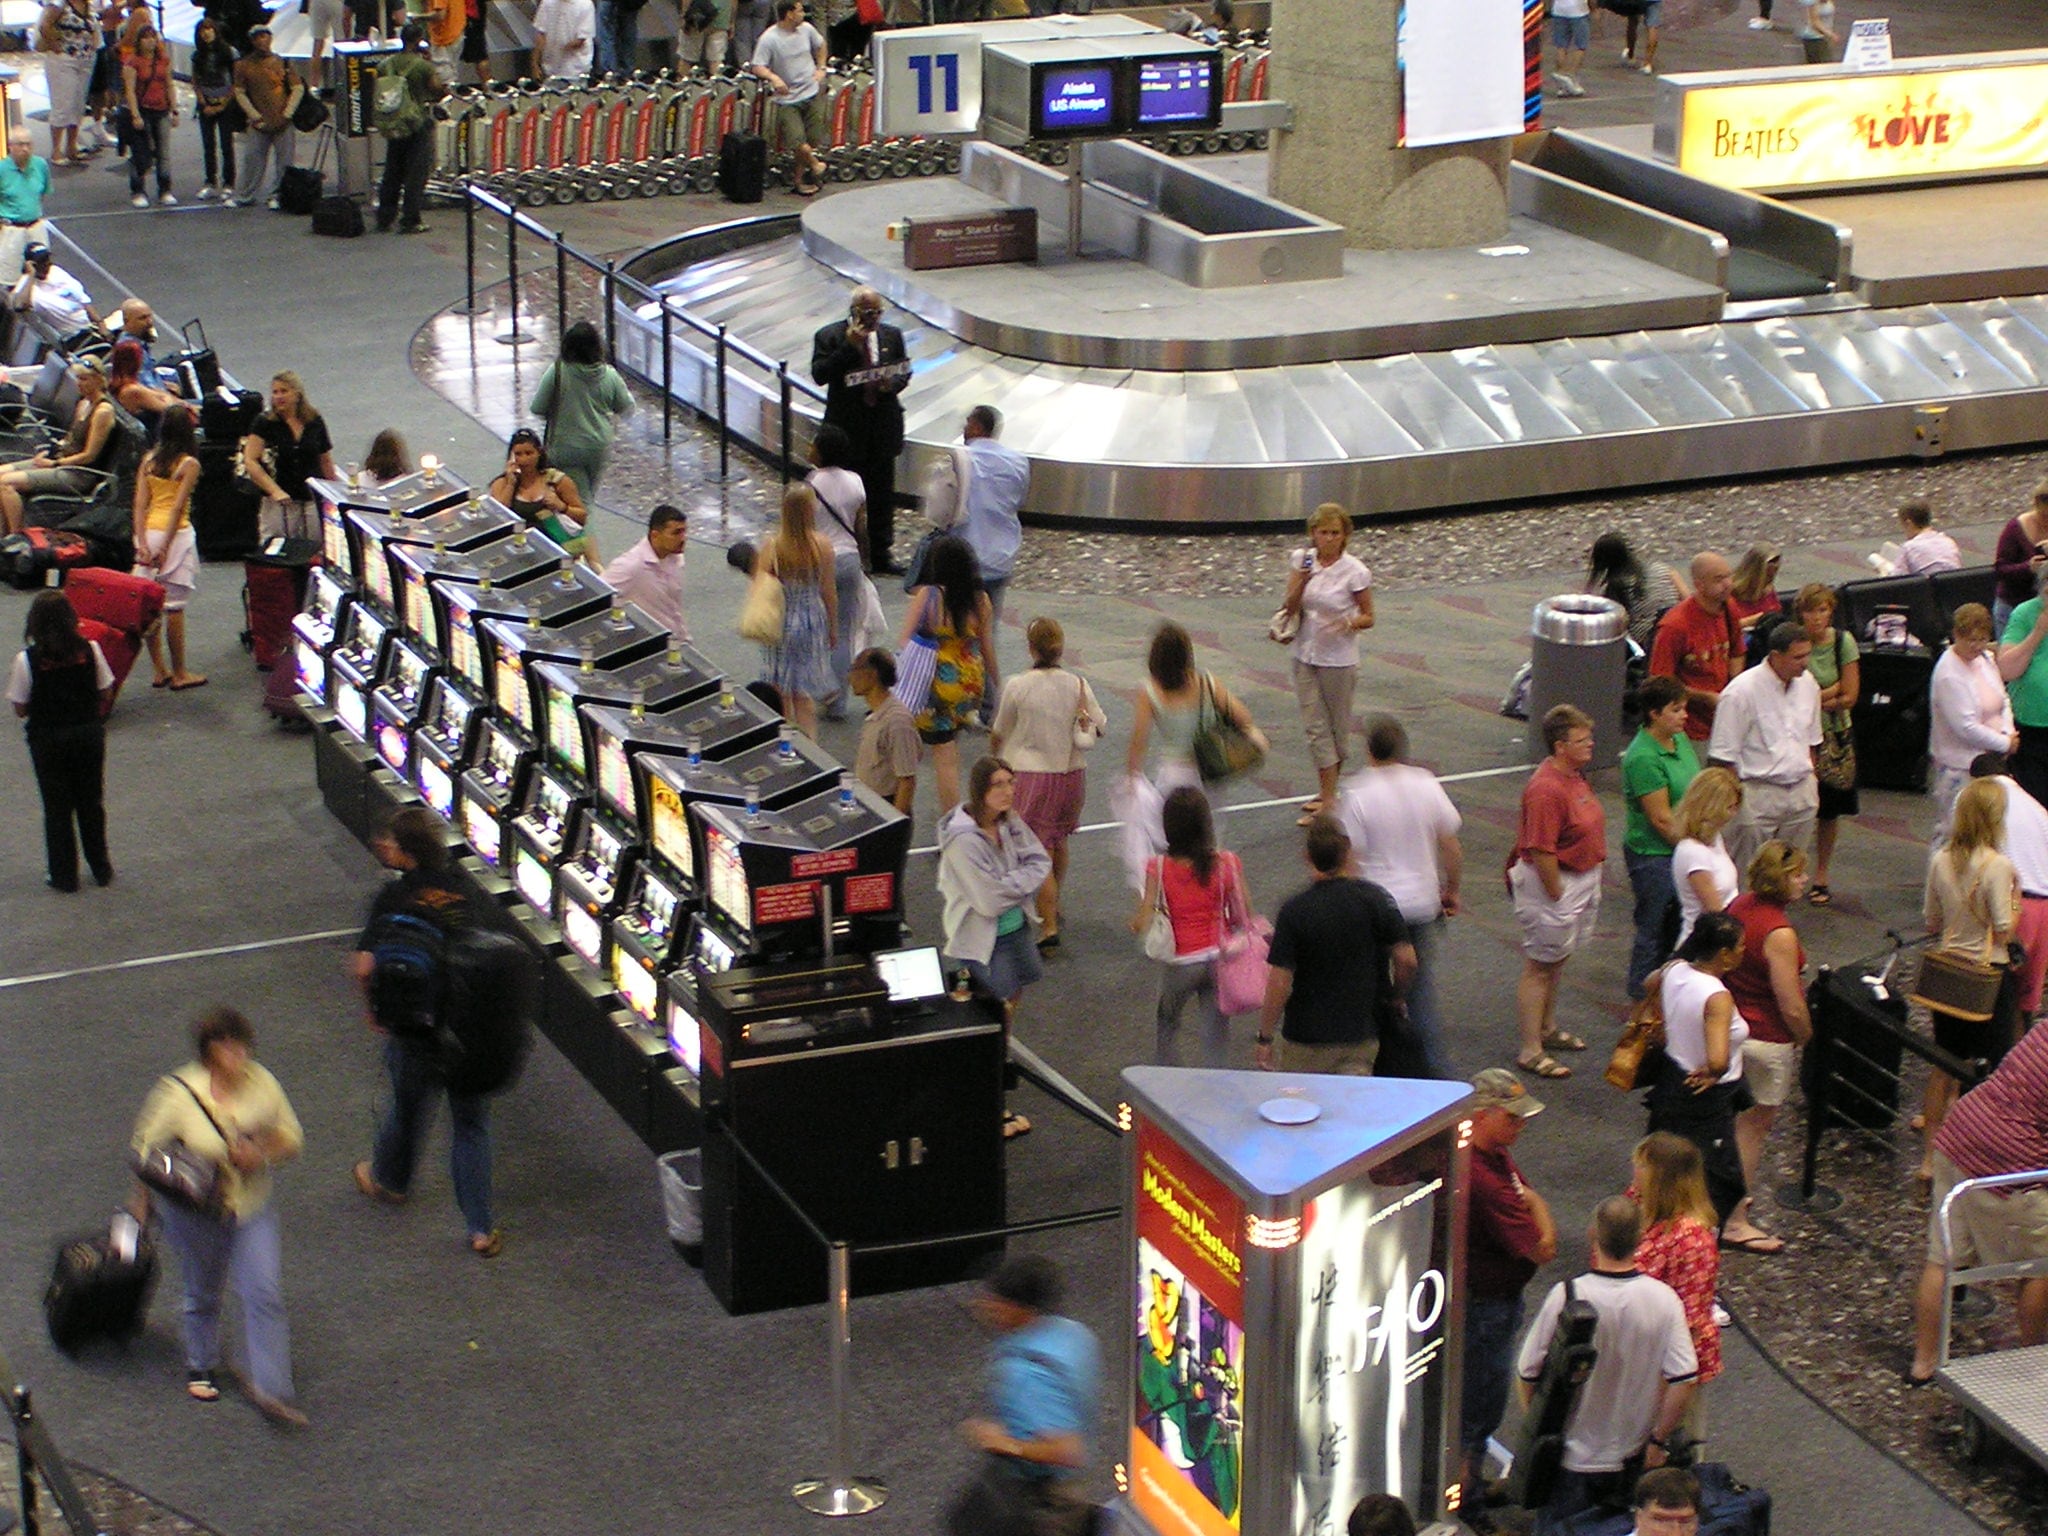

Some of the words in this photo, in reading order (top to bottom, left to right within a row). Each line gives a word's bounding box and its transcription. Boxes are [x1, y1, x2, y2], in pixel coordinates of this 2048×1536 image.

[908, 53, 958, 114] 11
[1061, 81, 1096, 95] Alaska
[1049, 98, 1068, 113] US
[1069, 97, 1106, 112] Airways
[1714, 119, 1798, 159] BEATLES
[1868, 113, 1950, 149] LOVE
[1143, 1166, 1190, 1228] Modern
[1191, 1210, 1241, 1273] Masters
